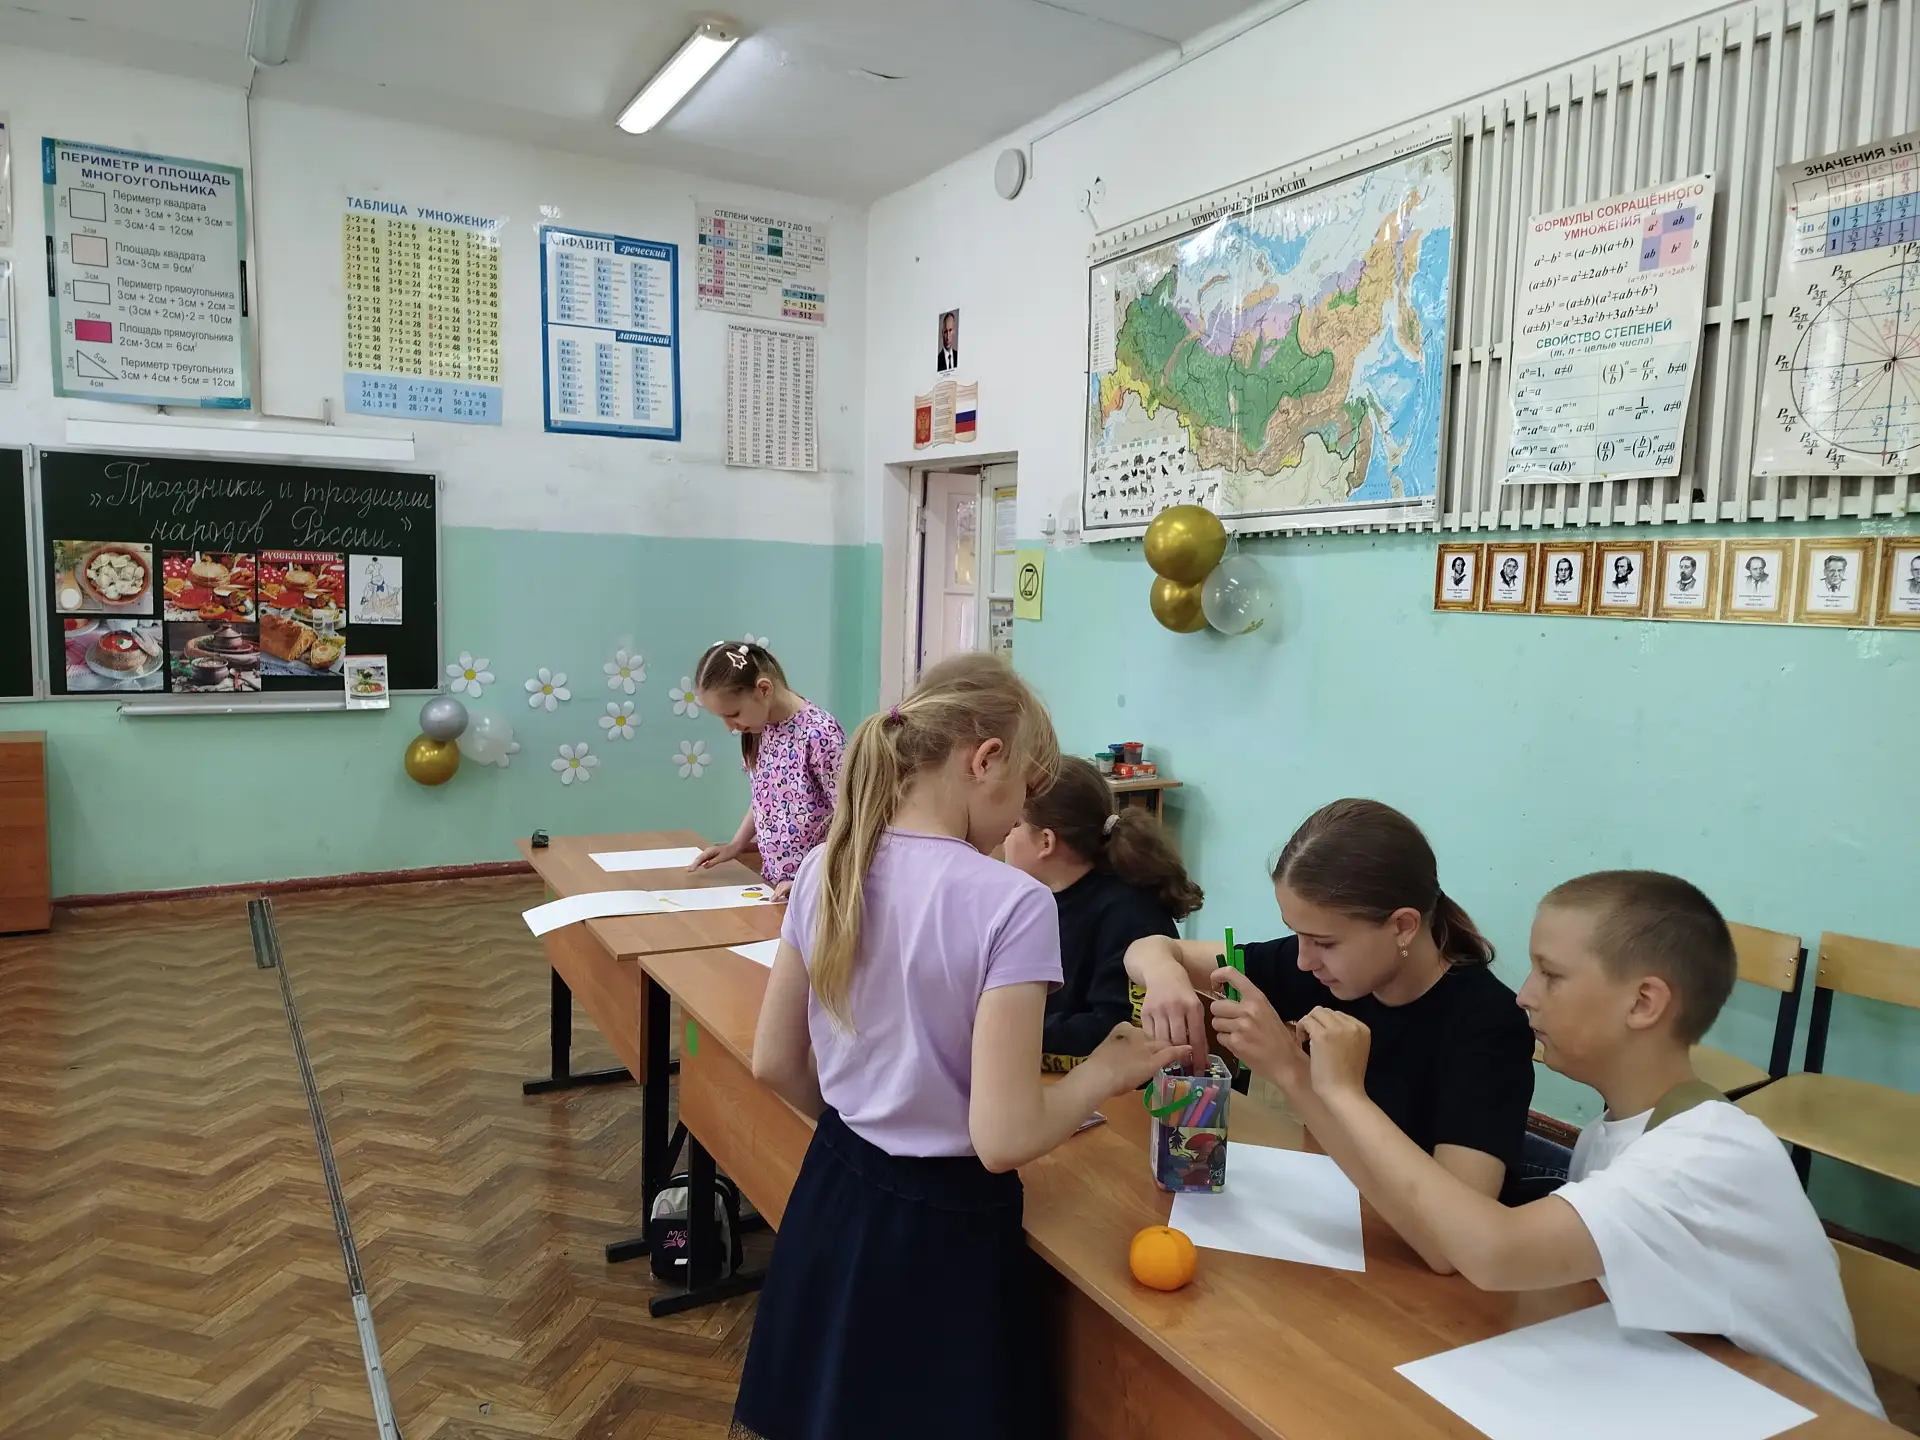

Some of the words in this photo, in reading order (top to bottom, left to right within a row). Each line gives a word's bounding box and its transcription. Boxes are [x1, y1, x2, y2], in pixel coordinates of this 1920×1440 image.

[61, 151, 139, 171] ПЕРИМЕТР
[145, 164, 153, 173] И
[159, 167, 230, 186] ПЛОЩАДЬ
[1805, 148, 1885, 176] ЗНАЧЕНИЯ
[1890, 141, 1913, 156] sin
[82, 169, 217, 197] МНОГОУГОЛЬНИКА
[113, 190, 161, 206] Периметр
[164, 199, 206, 212] квадрата
[1192, 201, 1242, 226] ПРИРОДНЫЕ
[1272, 178, 1307, 198] РОССИИ
[1535, 210, 1593, 233] ФОРМУЛЫ
[1597, 184, 1704, 218] СОКРАЩЁННОГО
[114, 204, 132, 215] 3см
[145, 208, 163, 219] 3см
[175, 212, 193, 223] 3см
[205, 215, 222, 227] 3см
[347, 196, 407, 216] ТАБЛИЦА
[418, 208, 495, 229] УМНОЖЕНИЯ
[715, 210, 748, 221] СТЕПЕНИ
[750, 216, 774, 225] ЧИСЕЛ
[793, 223, 803, 231] ДО
[1672, 214, 1684, 227] ab
[170, 225, 193, 236] 12см
[1564, 214, 1641, 241] УМНОЖЕНИЯ
[116, 242, 160, 257] Площадь
[163, 251, 206, 262] квадрата
[620, 245, 666, 258] греческий
[1644, 248, 1656, 260] ab
[117, 277, 162, 292] Периметр
[165, 284, 234, 299] прямоугольника
[800, 292, 817, 301] 2187
[118, 290, 136, 301] 3см
[149, 294, 166, 304] 2см
[178, 297, 196, 308] 3см
[208, 300, 226, 311] 2см
[799, 301, 816, 310] 3125
[209, 314, 232, 324] 10см
[799, 310, 812, 319] 512
[120, 322, 161, 337] Площадь
[164, 329, 233, 342] прямоугольника
[618, 332, 669, 345] латинский
[1537, 330, 1601, 349] СВОЙСТВО
[1605, 319, 1672, 340] СТЕПЕНЕЙ
[1585, 342, 1617, 353] целые
[1619, 335, 1653, 347] числа)
[121, 356, 169, 371] Периметр
[172, 363, 233, 375] треугольника
[90, 380, 104, 388] 4см
[121, 370, 140, 380] 3см
[152, 372, 170, 383] 4см
[181, 375, 199, 385] 5см
[212, 377, 235, 387] 12см
[279, 481, 293, 499] и
[304, 480, 432, 518] традиции
[150, 500, 273, 552] народов
[262, 551, 302, 560] РУССКАЯ
[305, 553, 333, 561] КУХНЯ
